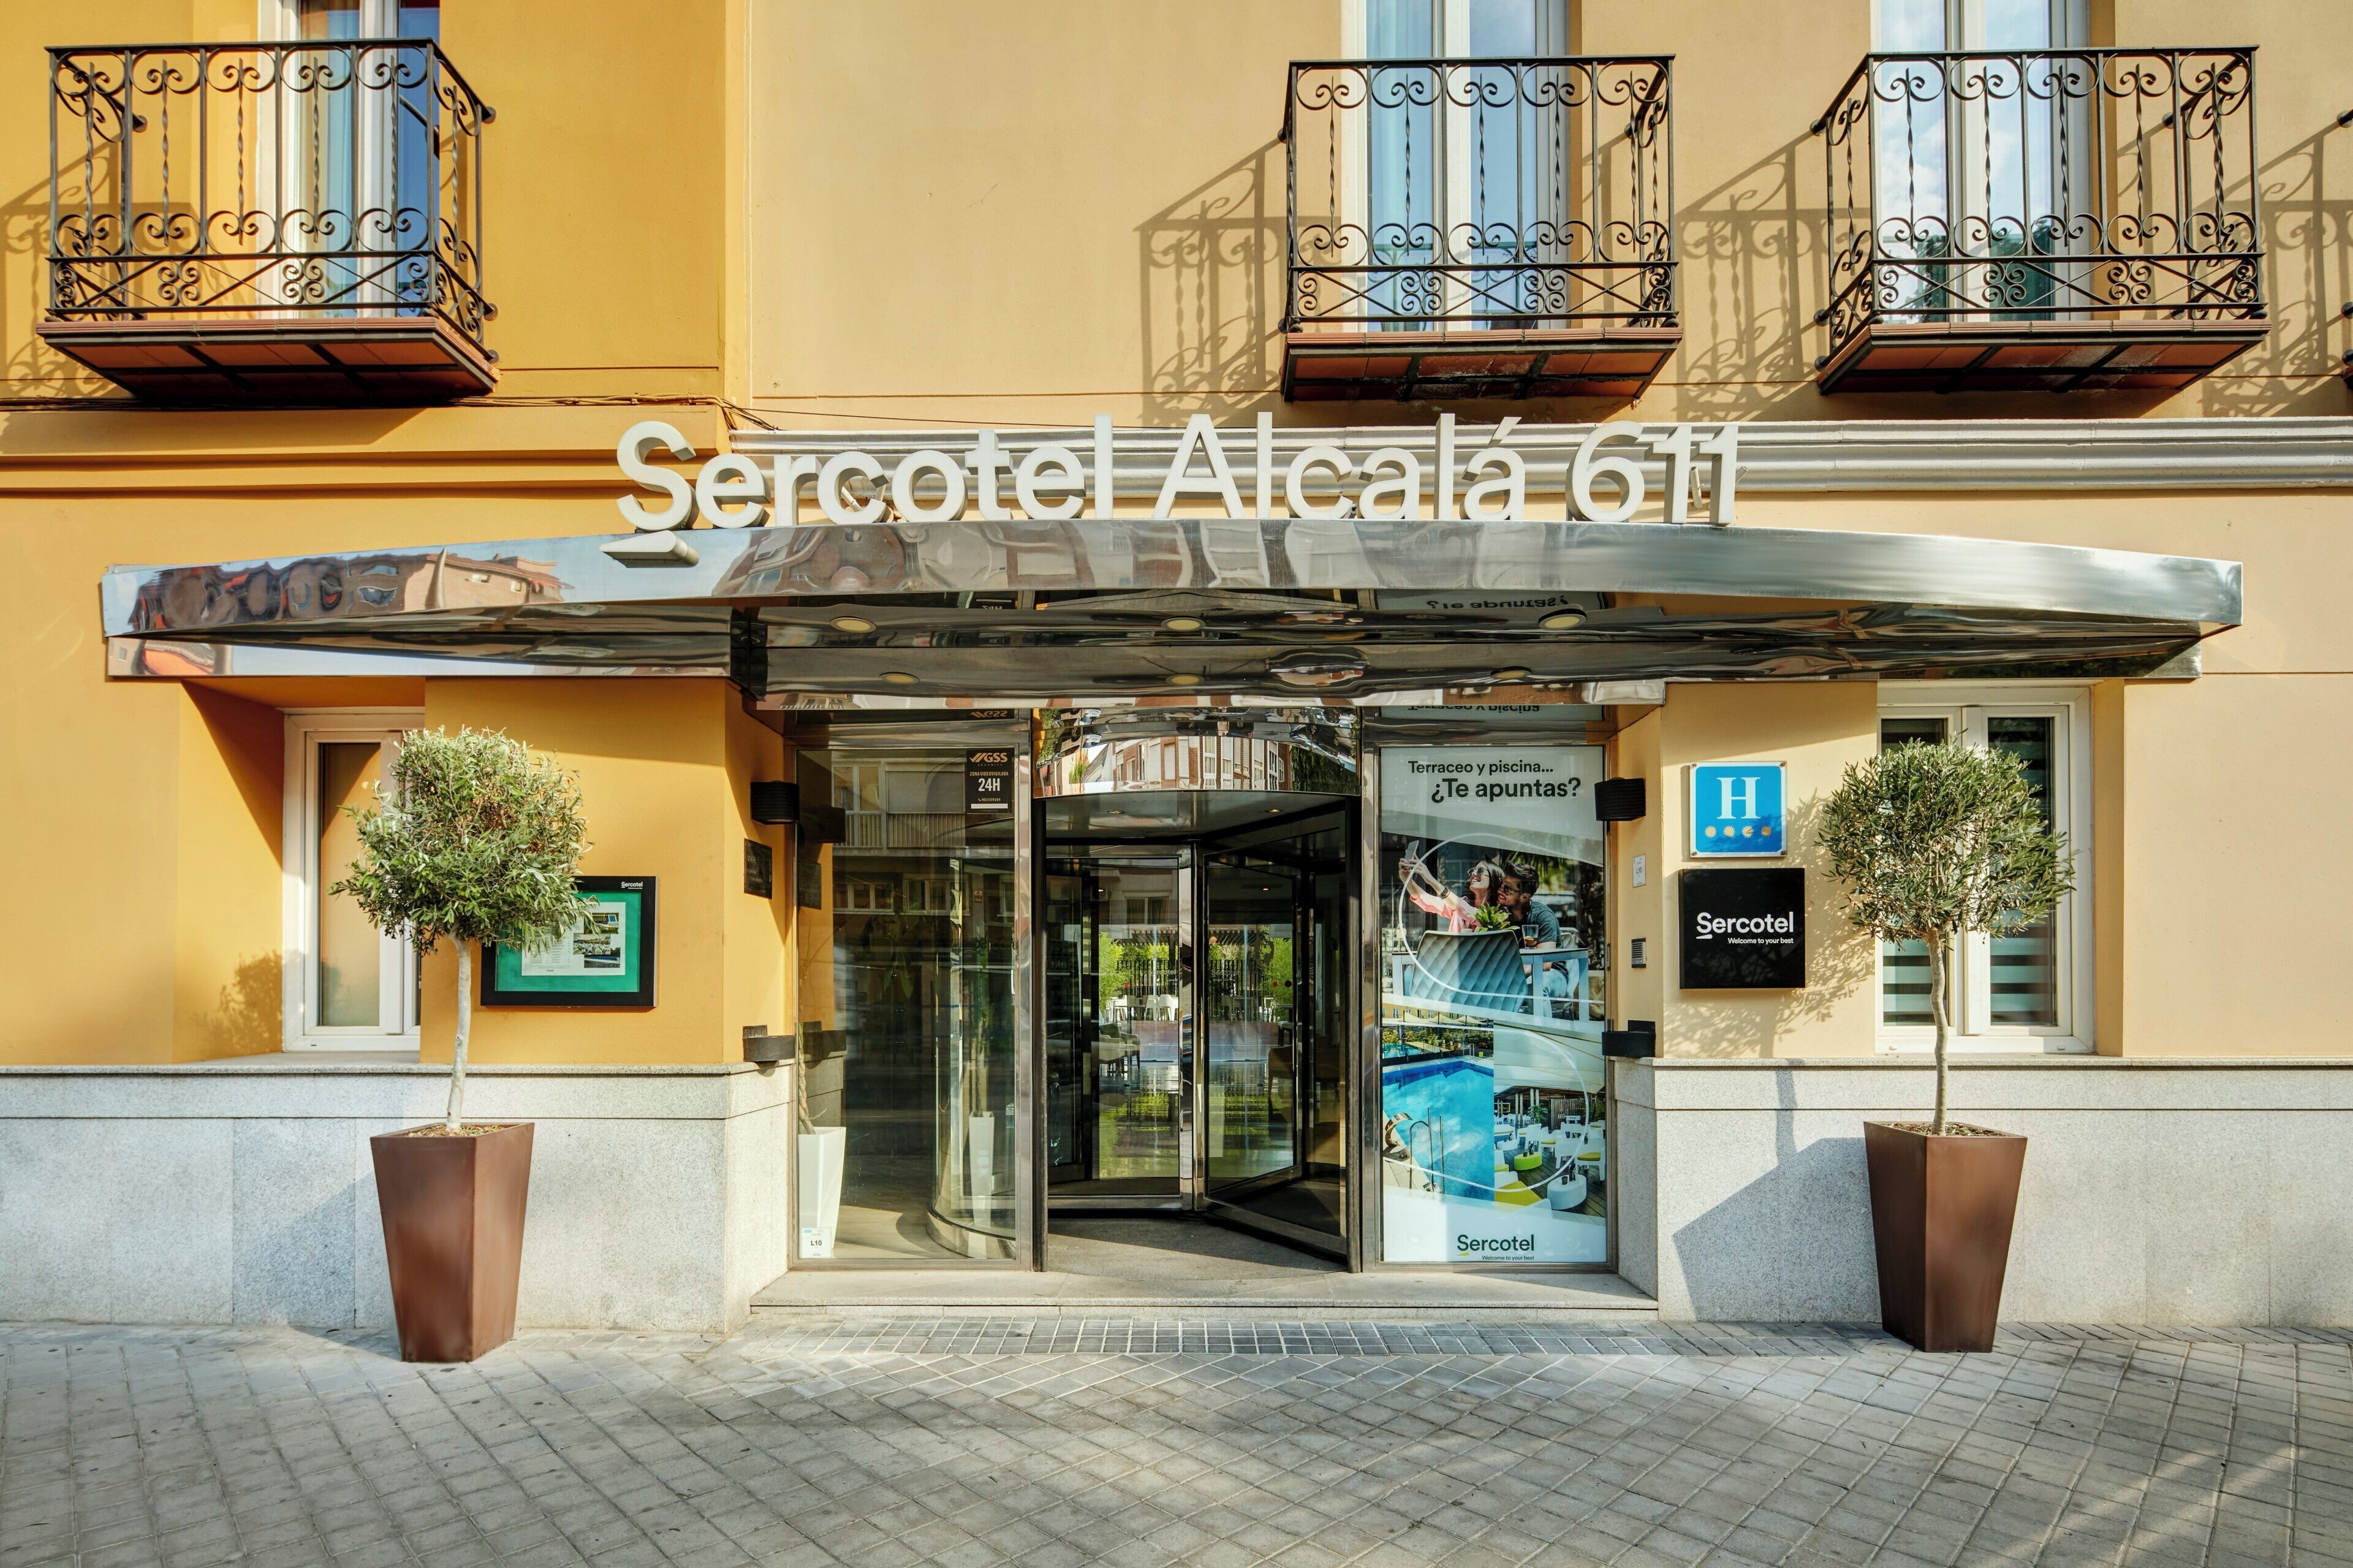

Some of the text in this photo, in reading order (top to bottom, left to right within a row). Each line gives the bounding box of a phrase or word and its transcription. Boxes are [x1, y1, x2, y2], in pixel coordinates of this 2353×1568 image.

[616, 412, 1738, 531] Sercotel Alcalá 611
[983, 752, 1008, 762] GSS
[1408, 759, 1553, 776] Terraceo y piscina...
[978, 778, 1000, 792] 24H
[1431, 777, 1581, 803] ¿Te apuntas?
[1716, 777, 1761, 819] H
[1696, 911, 1794, 934] Sercotel
[1457, 1234, 1534, 1252] Sercotel
